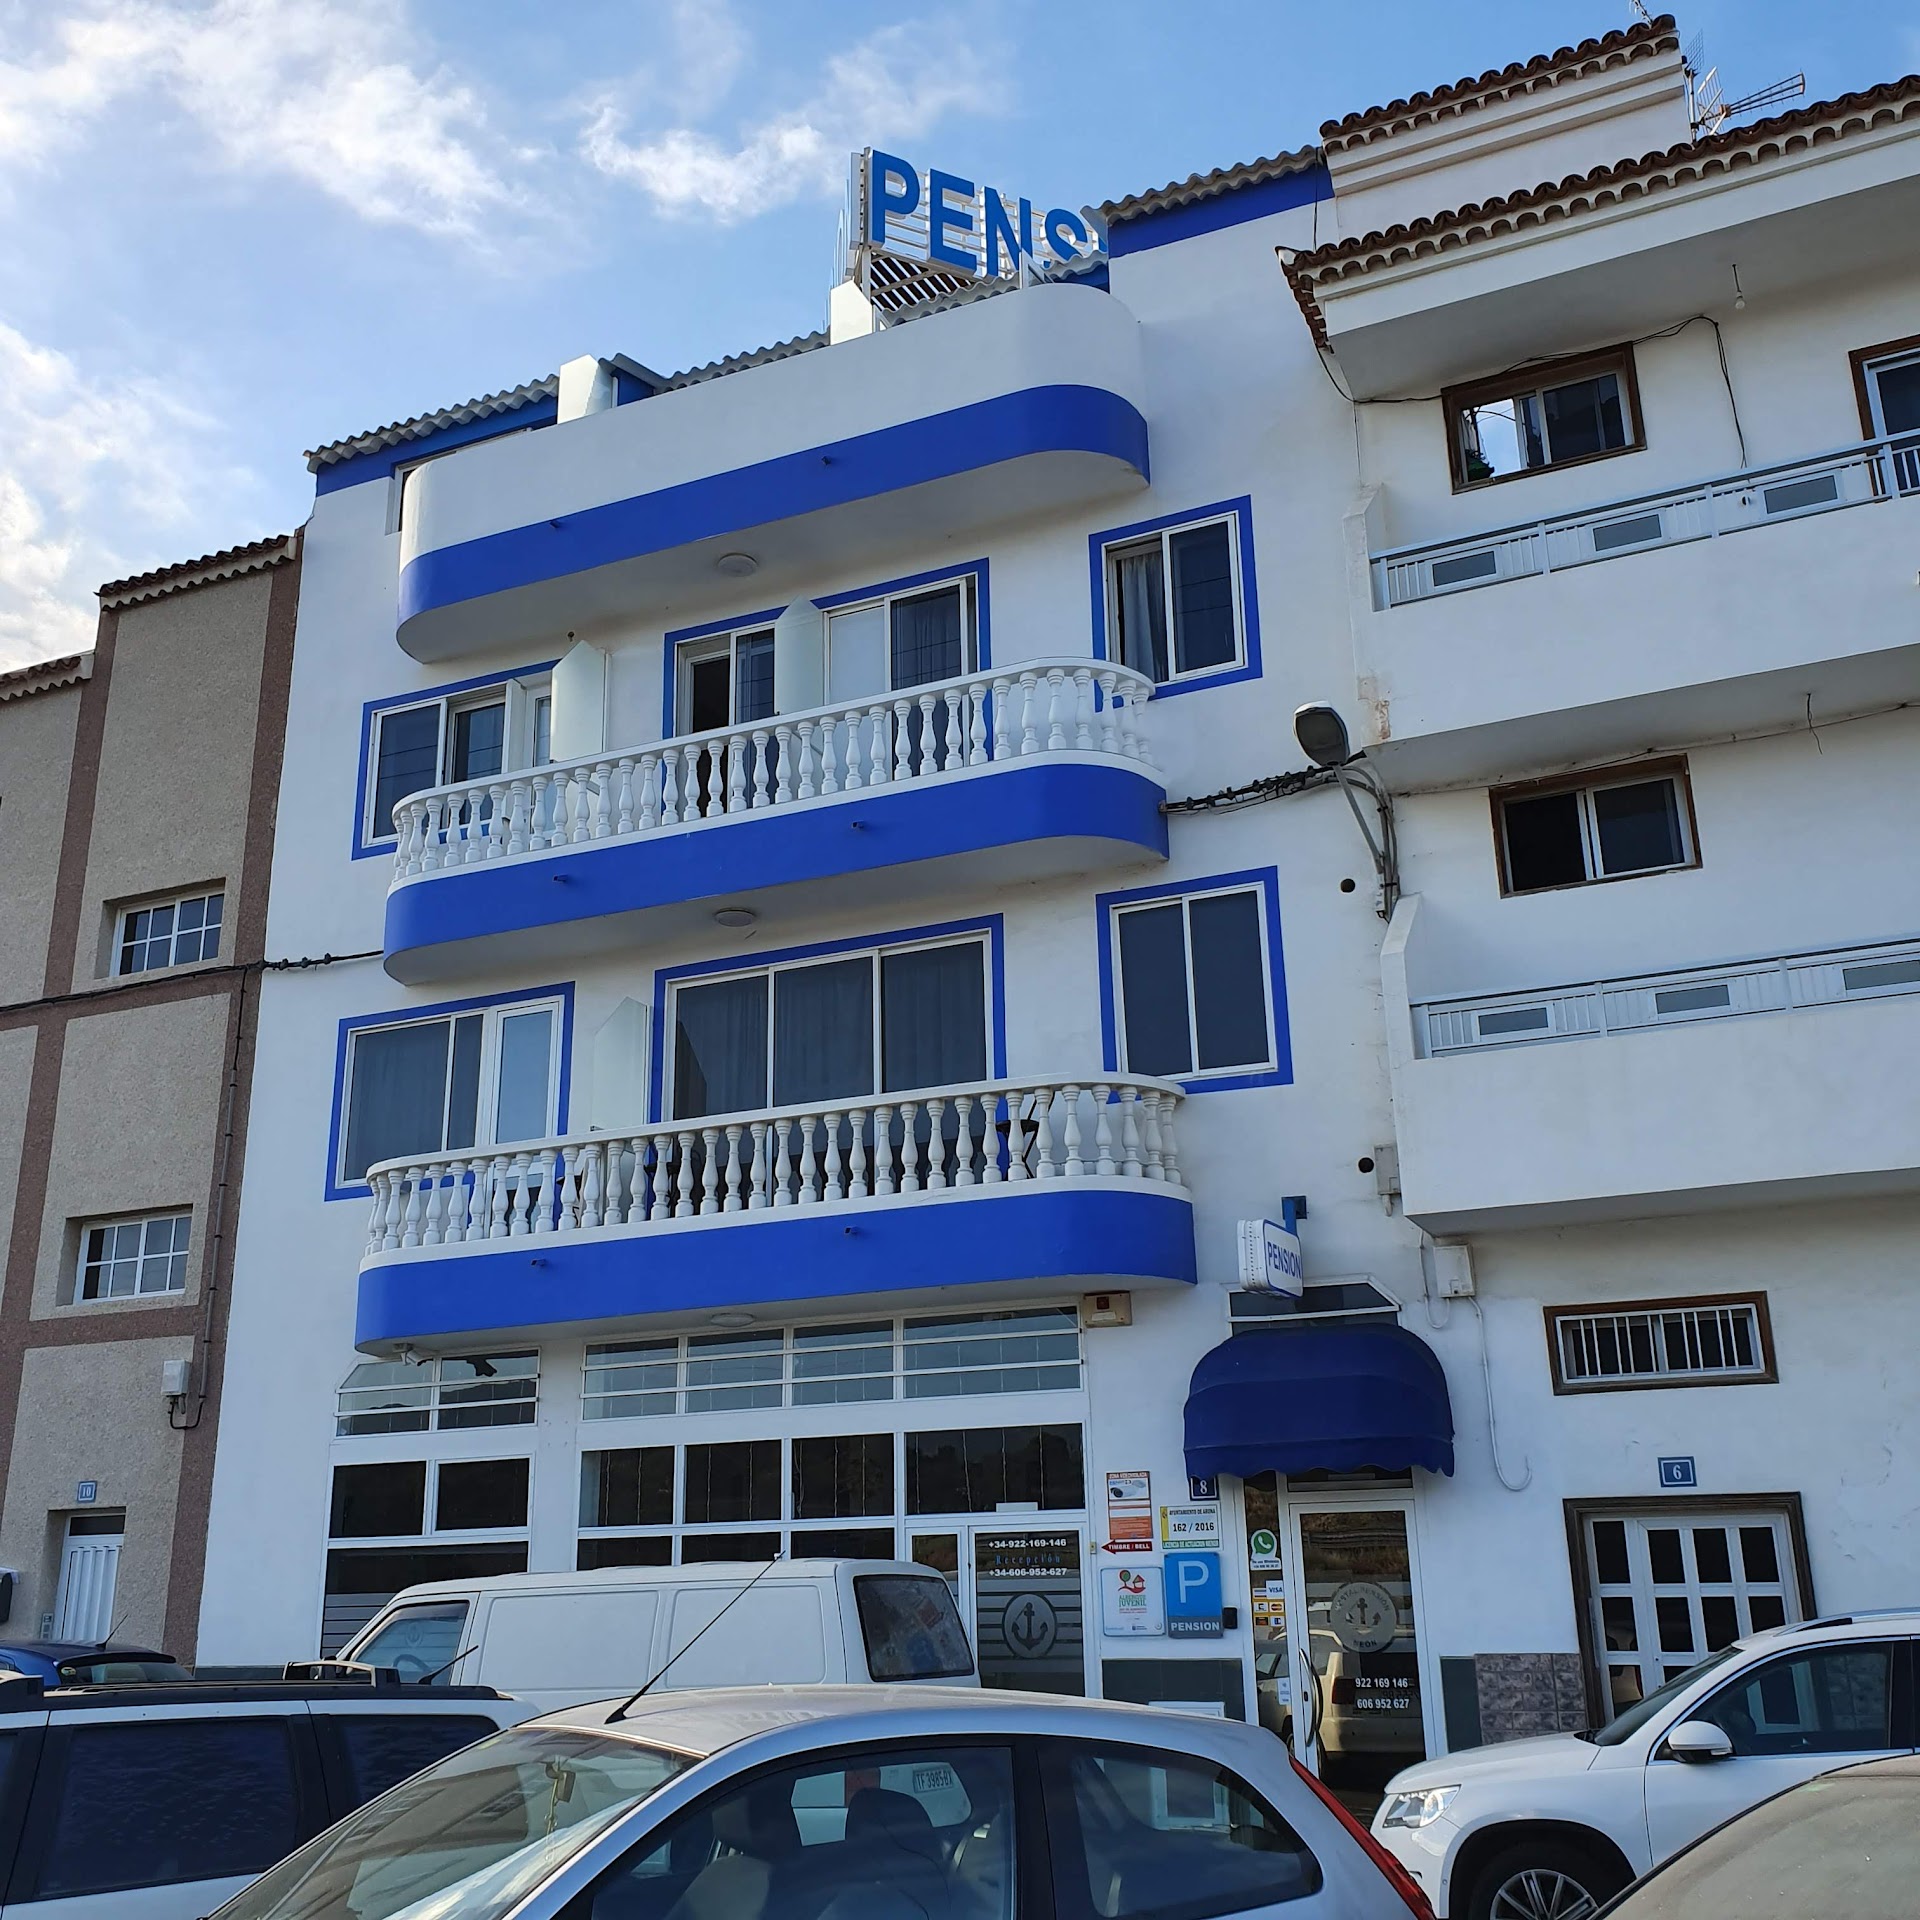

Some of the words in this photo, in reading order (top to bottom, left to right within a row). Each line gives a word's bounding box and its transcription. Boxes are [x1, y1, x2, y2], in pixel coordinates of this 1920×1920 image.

[872, 149, 1108, 276] PENS
[1267, 1241, 1302, 1280] PENSION
[1673, 1464, 1682, 1480] 6
[82, 1487, 91, 1497] 10
[1199, 1480, 1208, 1495] 8
[1173, 1523, 1187, 1532] 162
[1195, 1522, 1215, 1531] 2016
[989, 1539, 1067, 1548] +34-922-169-146
[989, 1568, 1068, 1577] +34-606-952-627
[1178, 1560, 1209, 1604] P
[1269, 1586, 1283, 1594] VISA
[1170, 1621, 1220, 1632] PENSION
[1355, 1678, 1372, 1688] 922
[1374, 1678, 1390, 1688] 169
[1392, 1677, 1408, 1688] 146
[1357, 1699, 1373, 1709] 606
[1375, 1698, 1391, 1709] 952
[1393, 1698, 1409, 1708] 627
